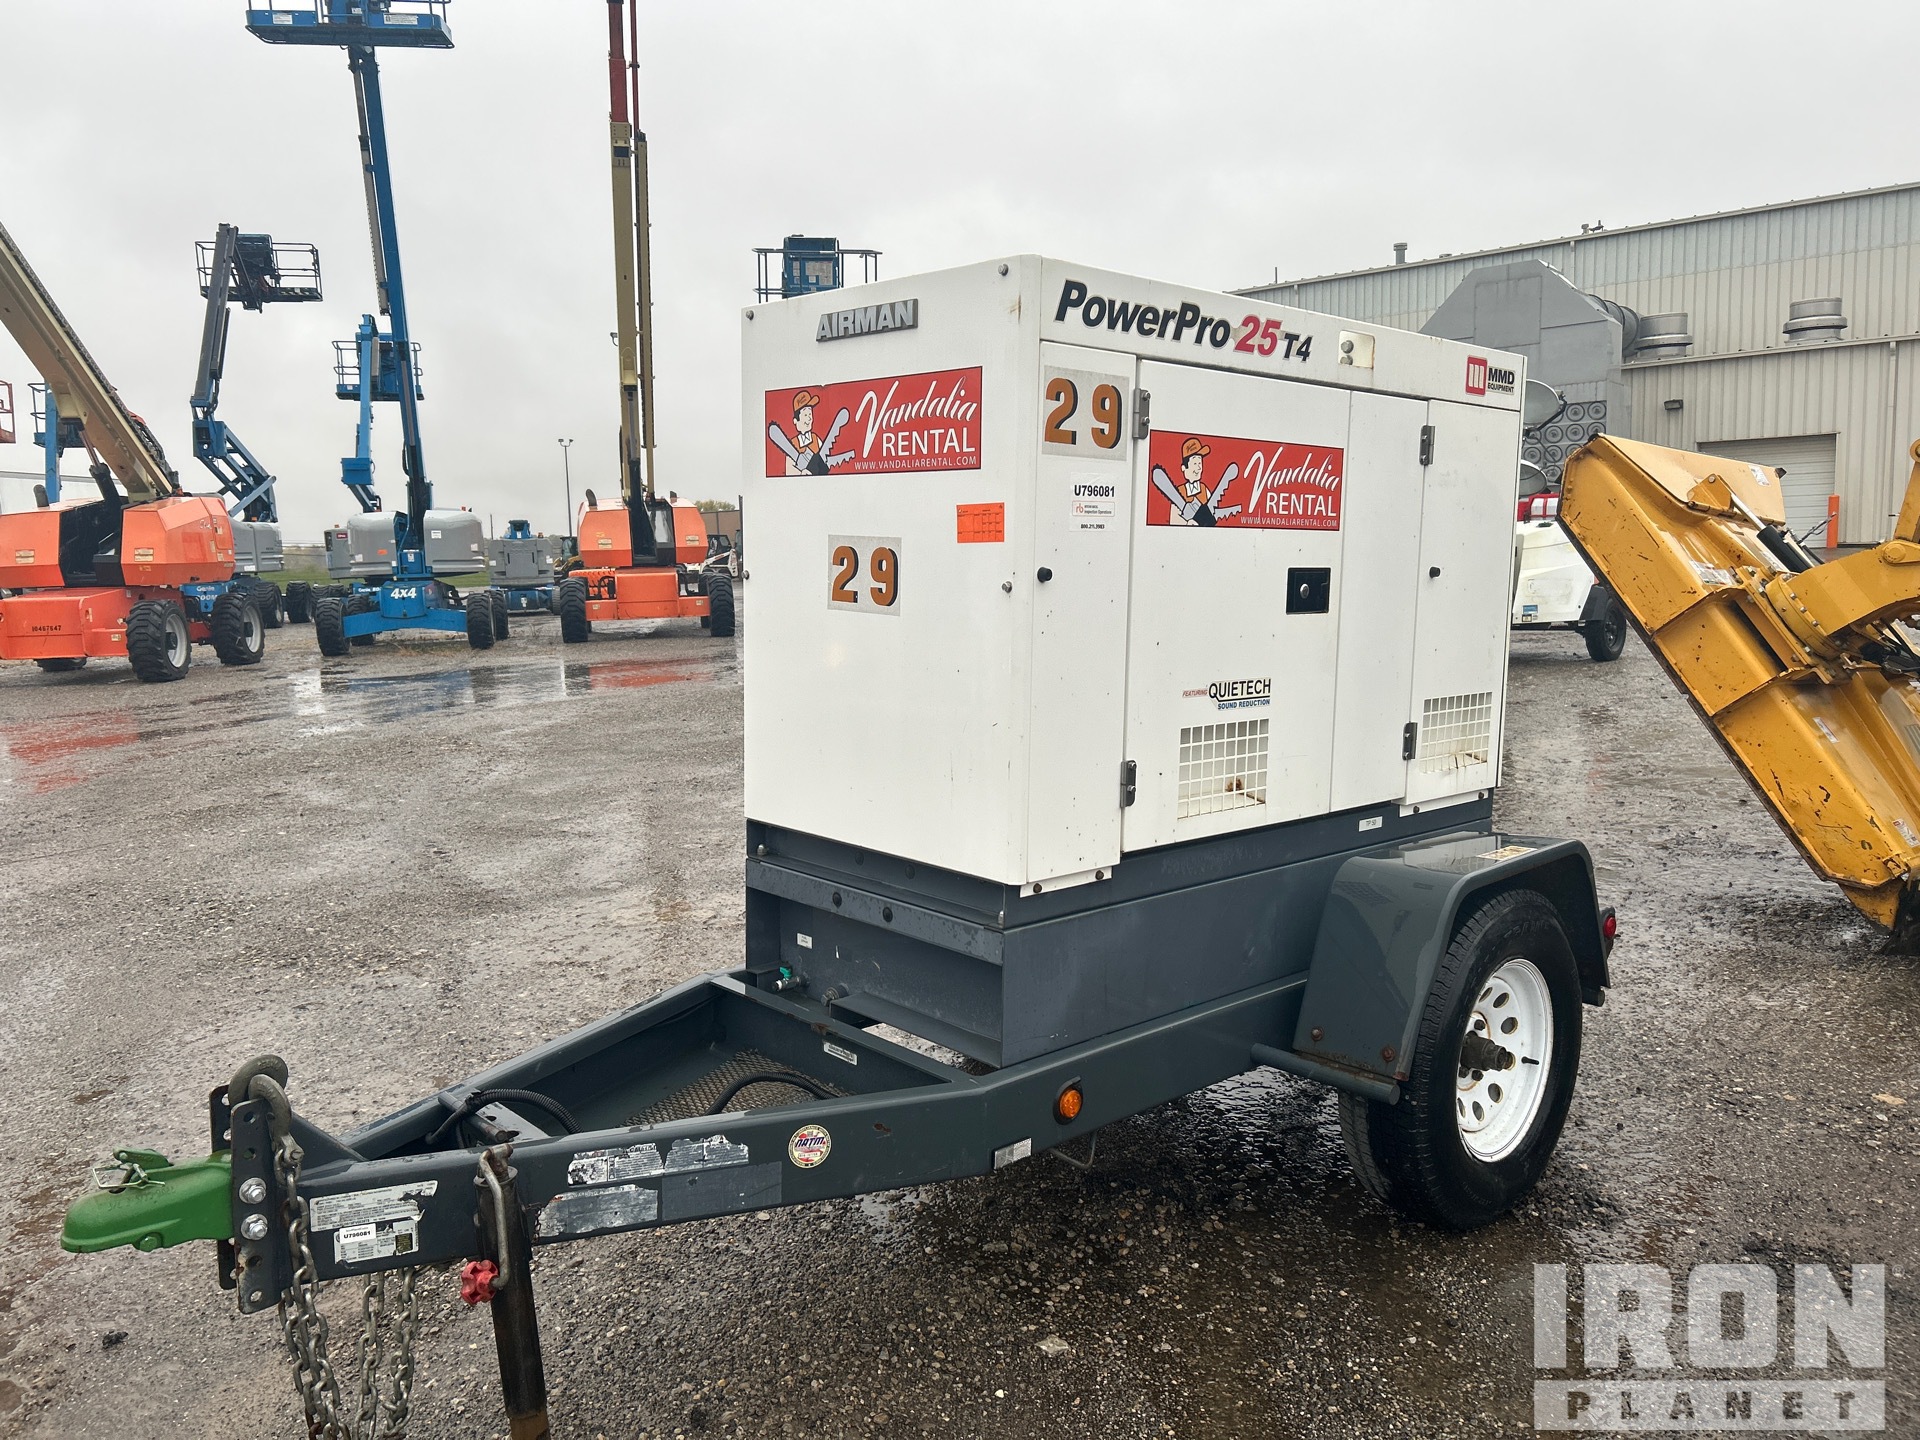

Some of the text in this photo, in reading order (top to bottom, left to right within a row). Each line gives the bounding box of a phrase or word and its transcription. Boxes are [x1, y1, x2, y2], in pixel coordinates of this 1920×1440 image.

[816, 299, 914, 340] AIRMAN
[1055, 279, 1313, 362] PowerPro 25 T4
[1488, 368, 1515, 385] MMD
[1487, 382, 1514, 393] EQUIPMENT
[855, 375, 978, 459] Vandalia
[882, 427, 976, 458] RENTAL
[854, 456, 977, 470] WWW.VANDALIARENTAL.COM
[1243, 446, 1340, 513] Vandalia
[1074, 484, 1115, 497] U796081
[1265, 492, 1337, 517] RENTAL
[1240, 516, 1337, 528] WWW.VANDALIARENTAL.COM
[1182, 679, 1271, 699] FEATURING QUIETECH
[1218, 699, 1270, 710] SOUND REDUCTION
